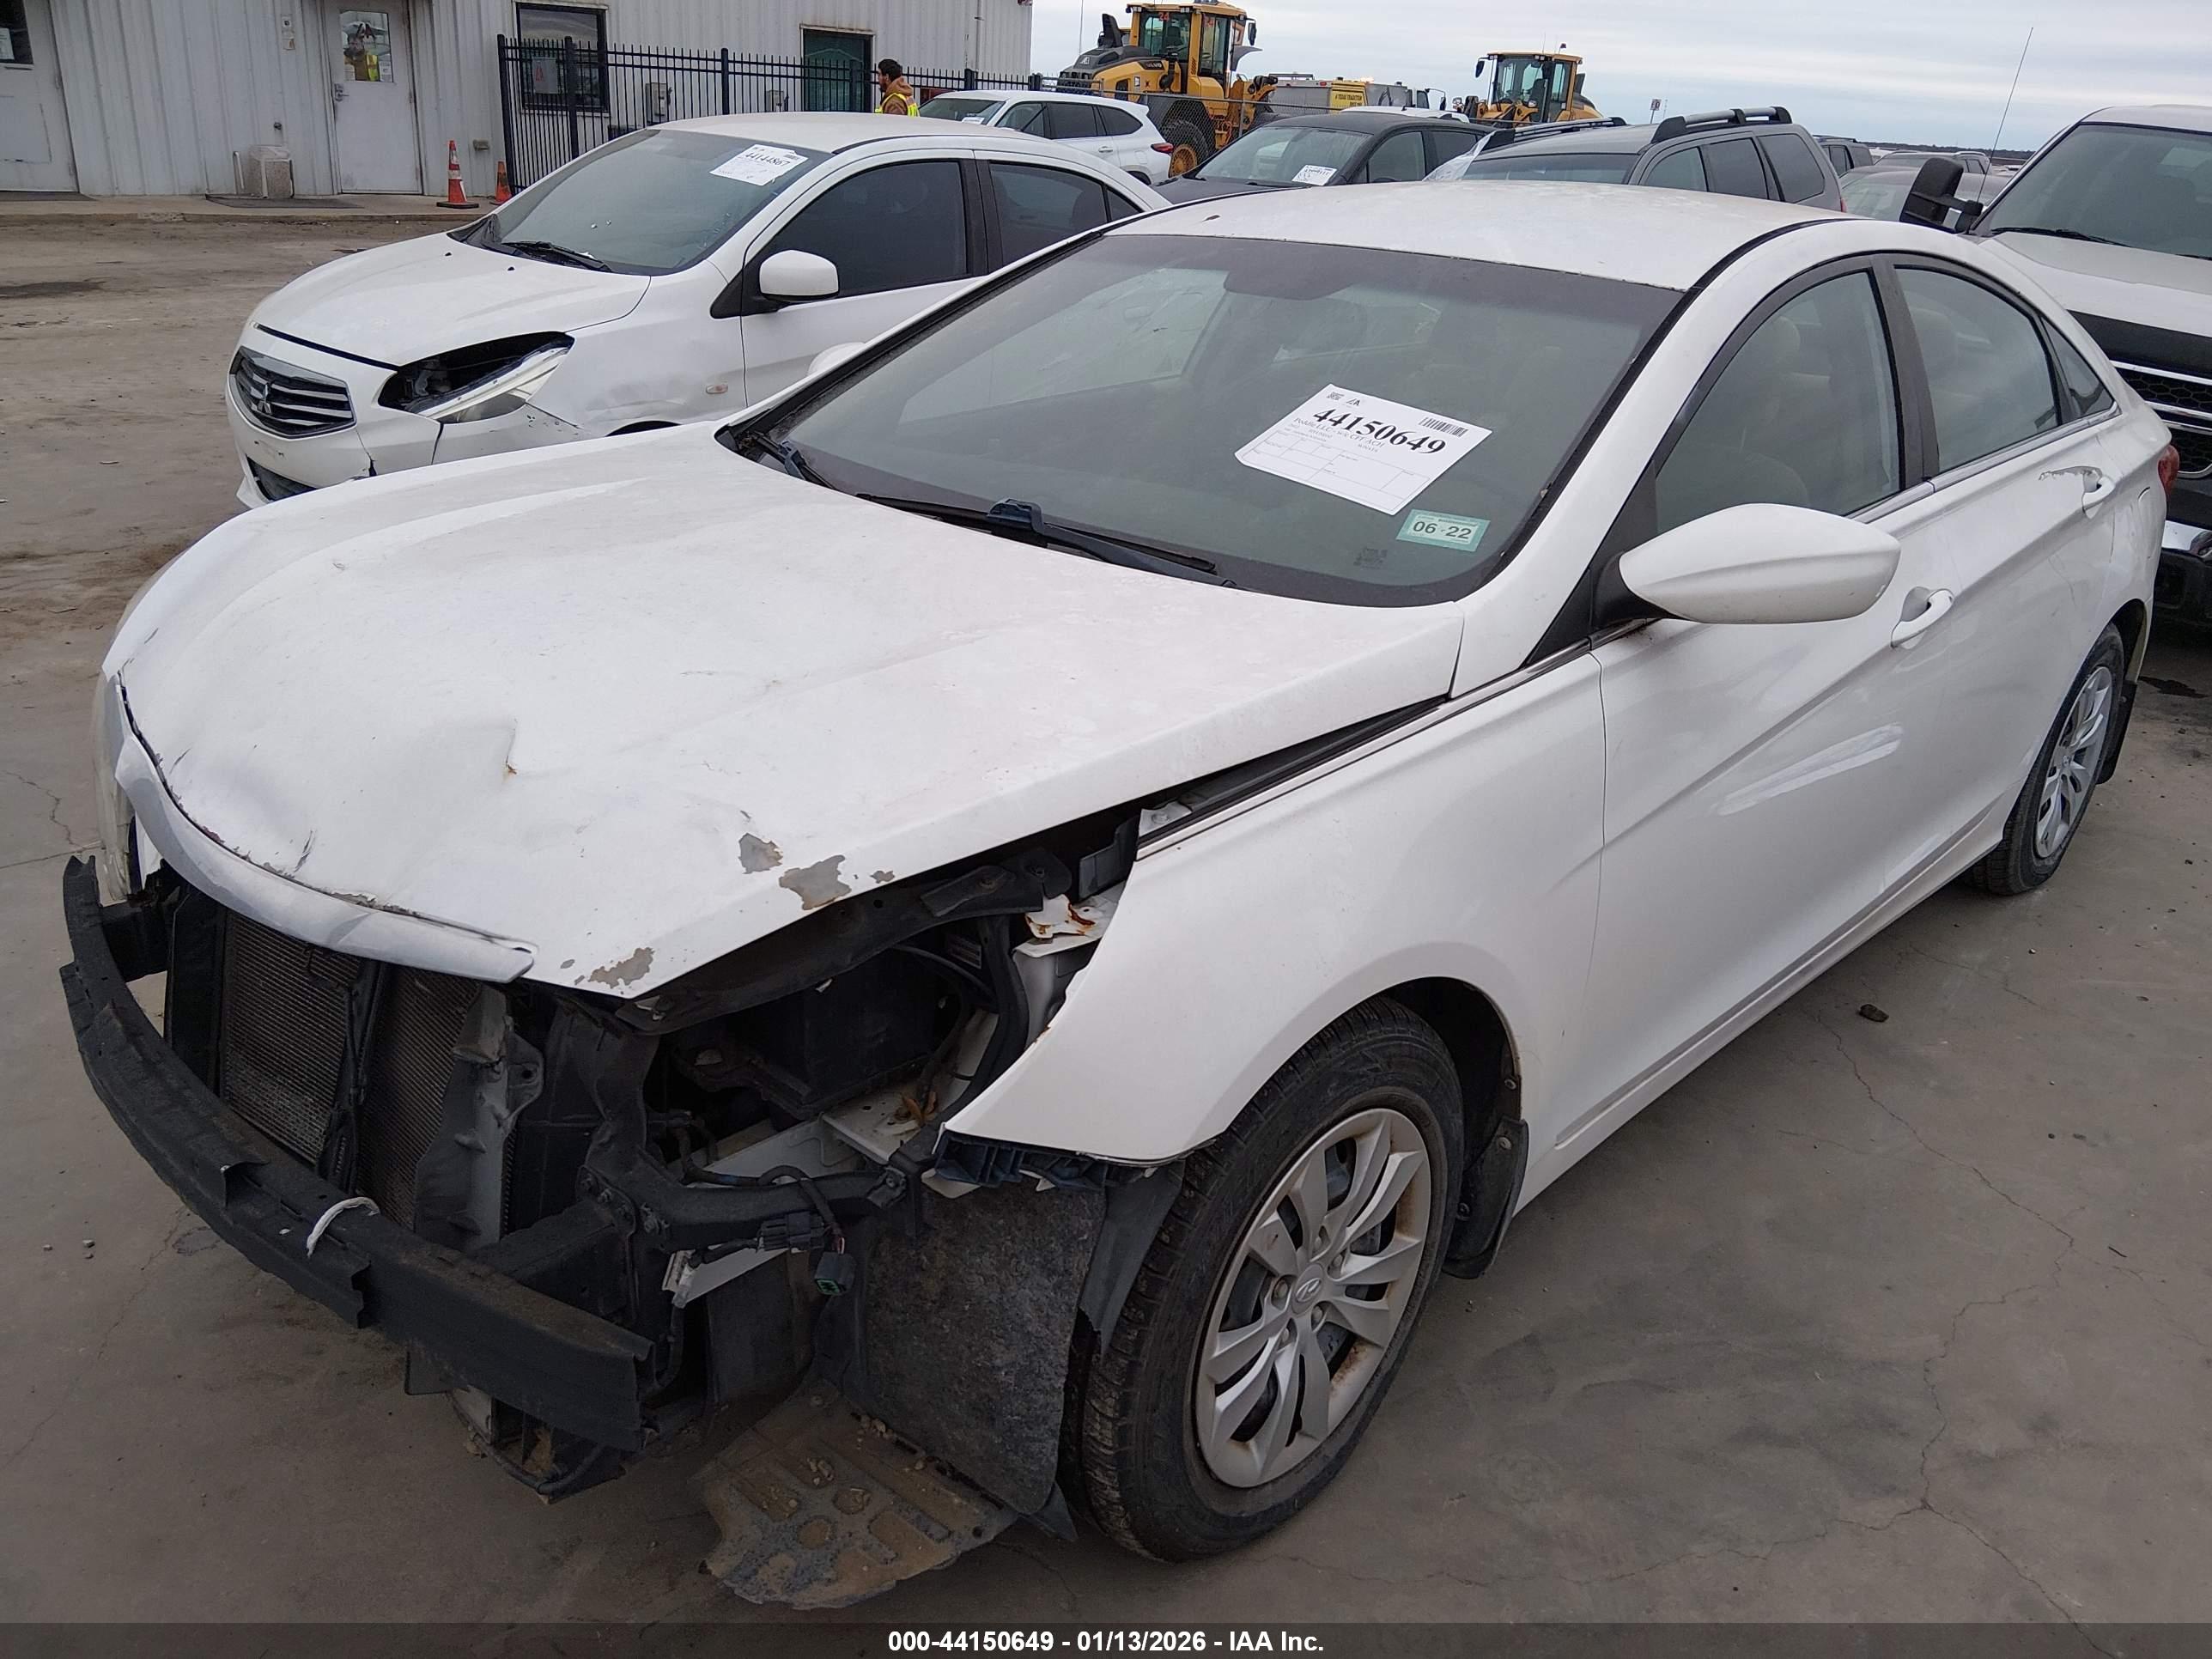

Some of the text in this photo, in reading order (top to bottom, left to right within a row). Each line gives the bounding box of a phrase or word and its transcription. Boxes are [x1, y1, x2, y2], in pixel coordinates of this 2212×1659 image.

[1313, 409, 1446, 454] 44150649
[1413, 520, 1437, 534] 06
[1445, 526, 1472, 539] 22
